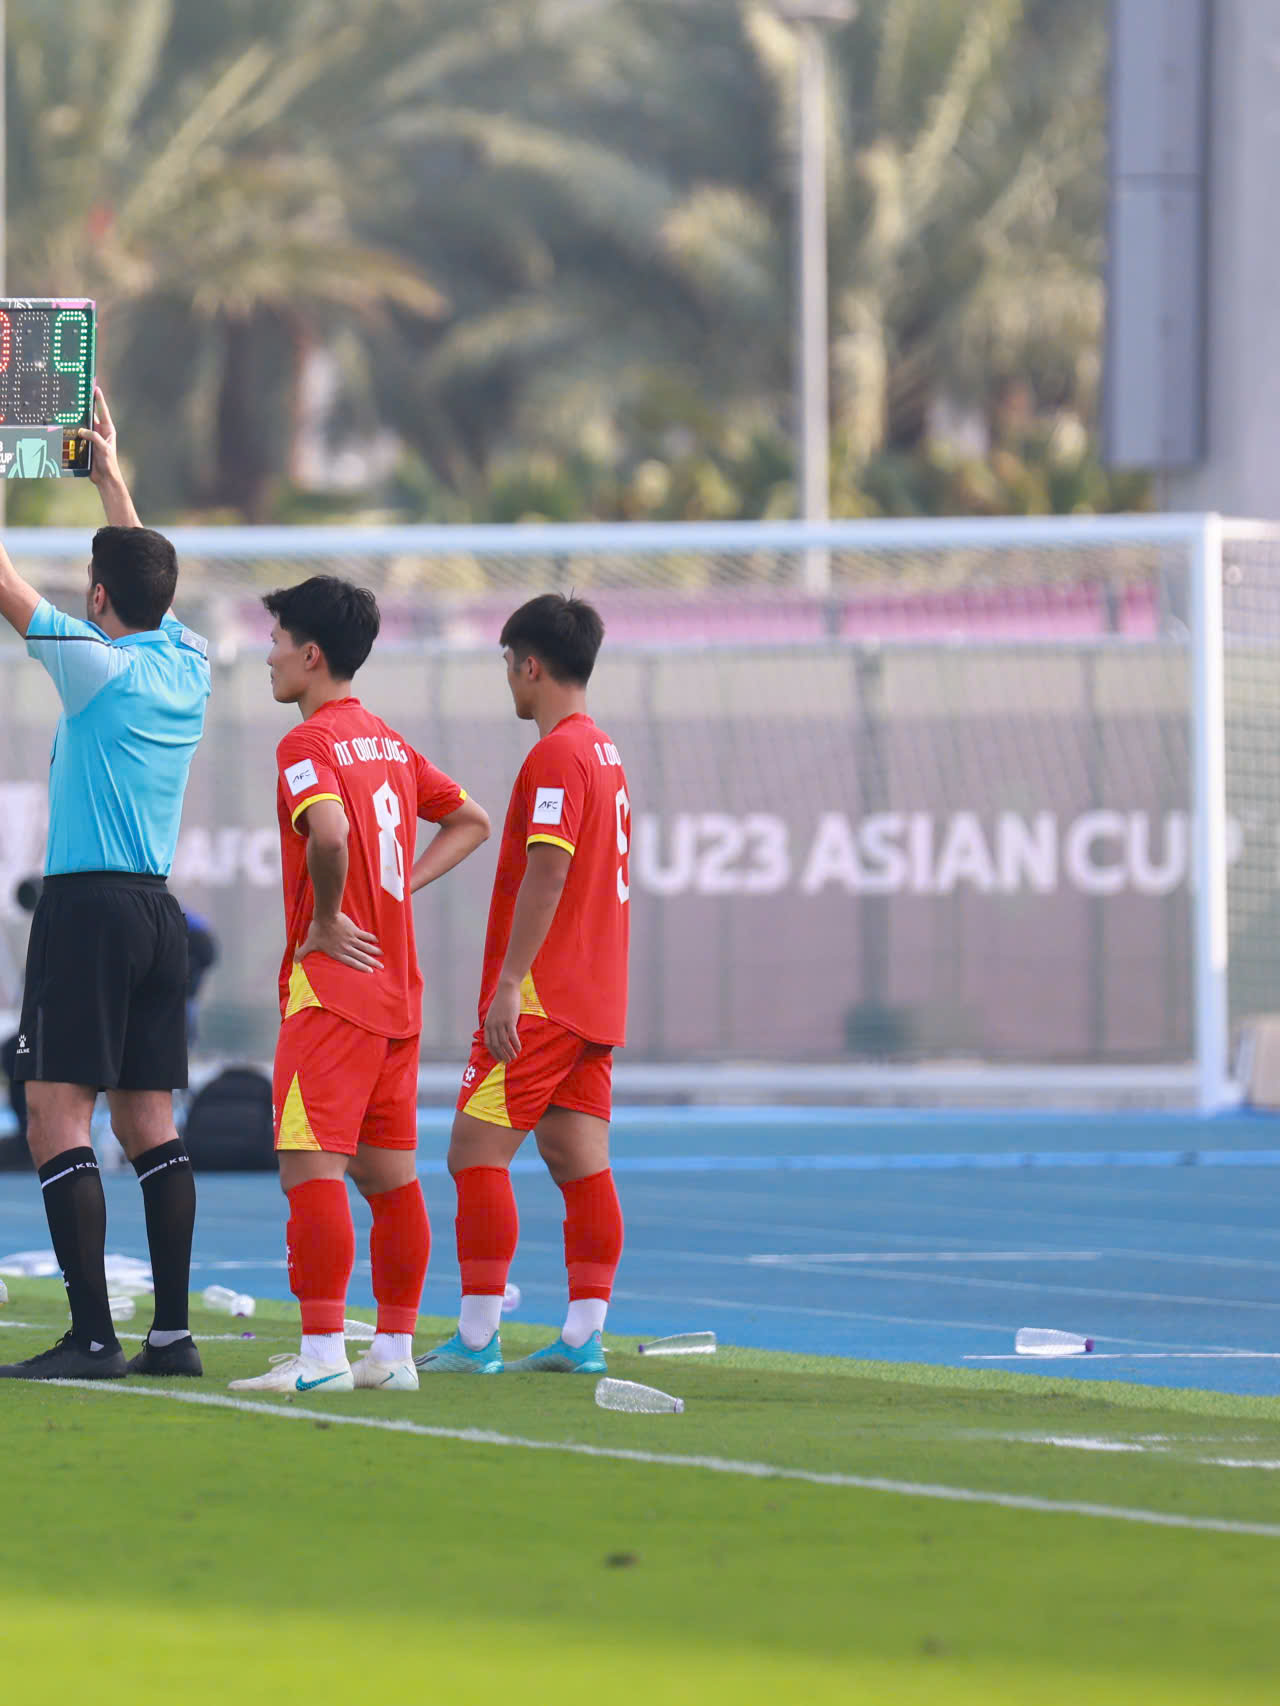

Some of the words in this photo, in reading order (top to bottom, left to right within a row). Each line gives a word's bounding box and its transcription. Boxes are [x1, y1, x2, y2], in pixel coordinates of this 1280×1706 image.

[53, 310, 88, 424] 9
[292, 769, 311, 784] AFC
[538, 800, 558, 810] AFC
[372, 779, 405, 902] 8
[634, 812, 790, 895] U23
[804, 811, 1060, 896] ASIAN
